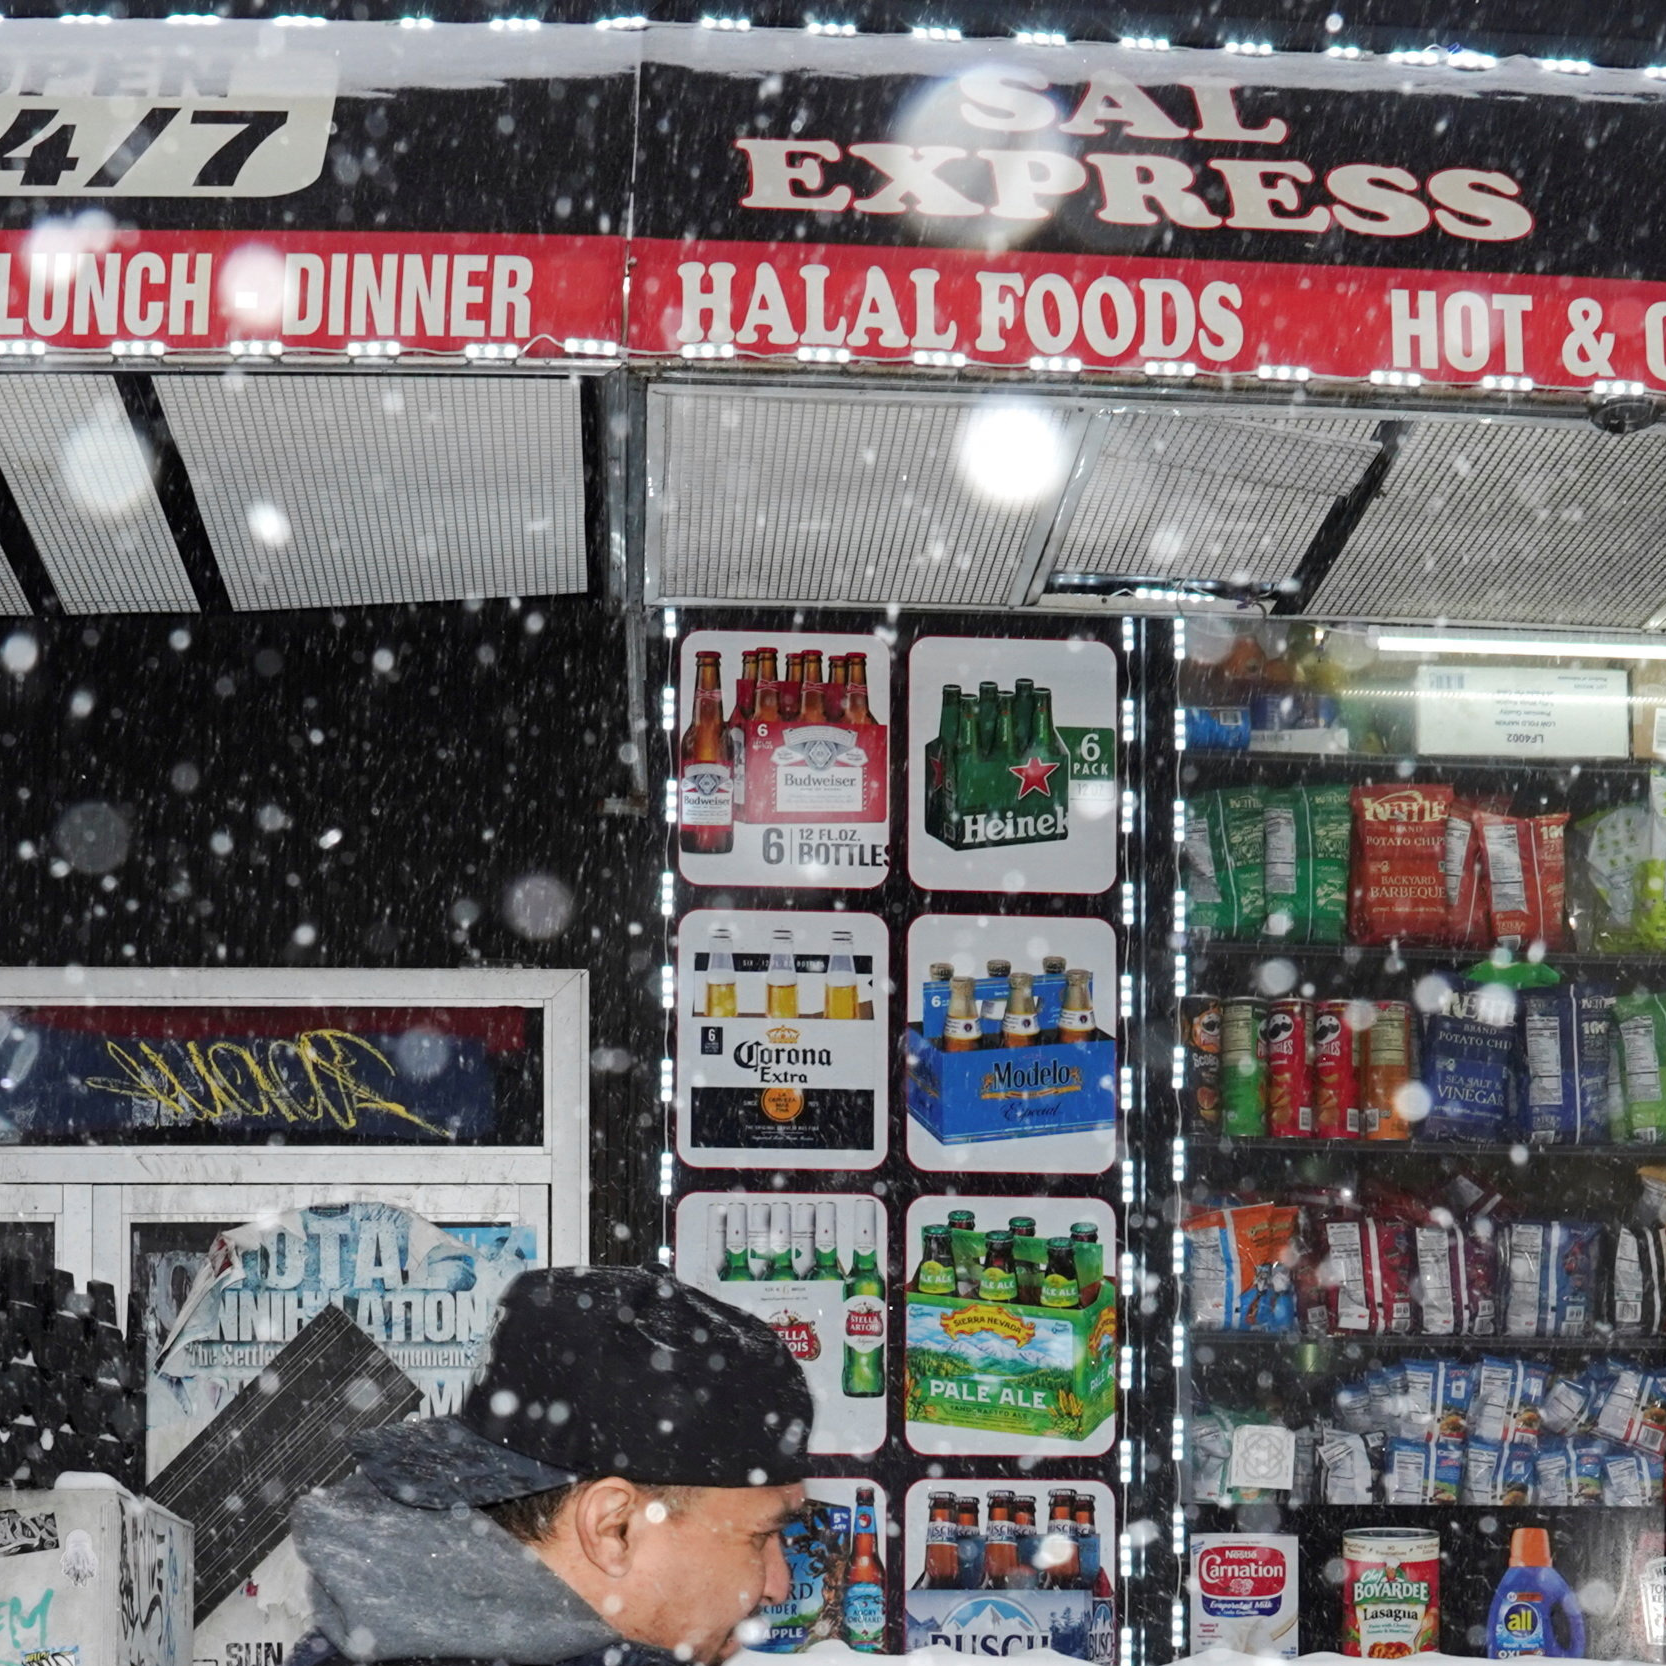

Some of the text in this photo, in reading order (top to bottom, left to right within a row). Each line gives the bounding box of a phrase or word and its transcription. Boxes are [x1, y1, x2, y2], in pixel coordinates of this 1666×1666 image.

[736, 138, 1535, 242] EXPRESS
[282, 254, 533, 340] DINNER
[677, 260, 957, 351] HALAL
[976, 271, 1244, 363] FOODS
[1390, 288, 1533, 374] HOT
[1561, 296, 1617, 378] &
[757, 723, 769, 738] 6
[1081, 733, 1101, 762] 6
[1073, 762, 1109, 776] PACK
[784, 773, 856, 787] Budweiser
[684, 795, 730, 806] Budweiser
[761, 827, 814, 865] 6 12
[1365, 836, 1411, 847] POTATO
[1381, 875, 1436, 886] BACKYARD
[1370, 886, 1447, 899] BARBEQUE
[708, 1028, 716, 1042] 6
[1438, 1031, 1483, 1047] POTATO
[733, 1040, 833, 1072] Corona
[760, 1066, 808, 1083] Extra
[993, 1059, 1071, 1089] Modelo
[1445, 1074, 1465, 1086] SEA
[1437, 1084, 1505, 1108] VINEGAR
[850, 1315, 880, 1324] STELLA
[953, 1316, 1023, 1334] SIERRA NEVADA
[849, 1324, 880, 1332] ARTOIS
[929, 1379, 1048, 1410] PALE ALE
[834, 1513, 849, 1525] 5%
[1201, 1557, 1284, 1584] Carnation
[1359, 1568, 1383, 1584] Chef
[1353, 1581, 1430, 1602] BOYARDEE
[1209, 1600, 1273, 1611] Evaporated Milk
[1363, 1605, 1419, 1622] Lasagna
[1507, 1608, 1532, 1633] all
[763, 1627, 804, 1640] APPLE
